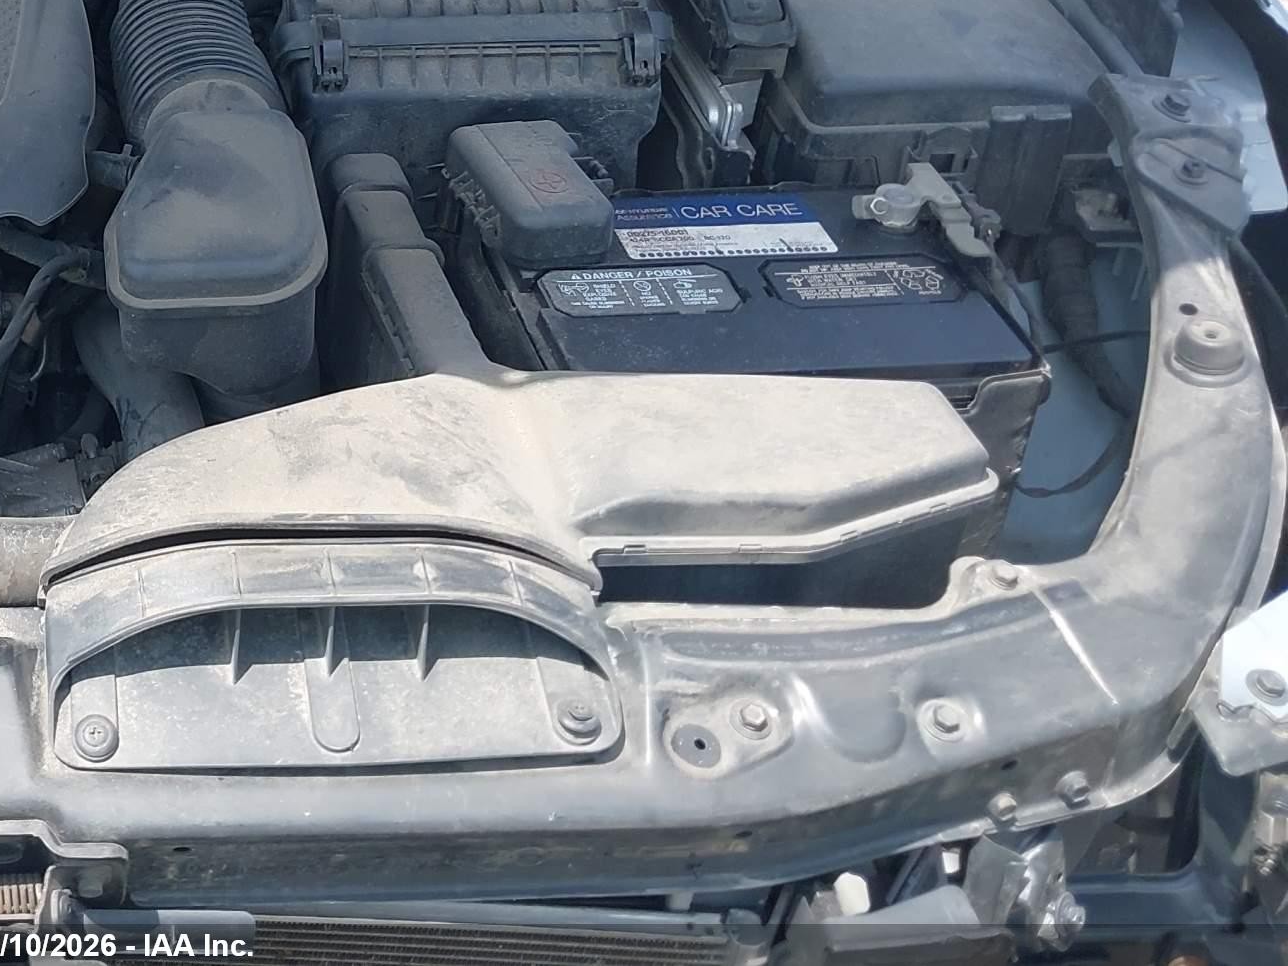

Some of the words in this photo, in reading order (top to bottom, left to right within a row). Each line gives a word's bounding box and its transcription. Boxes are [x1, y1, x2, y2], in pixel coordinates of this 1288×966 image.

[680, 205, 733, 220] CAR
[736, 202, 804, 218] CARE
[582, 271, 634, 281] DANGER
[644, 268, 693, 278] POISON
